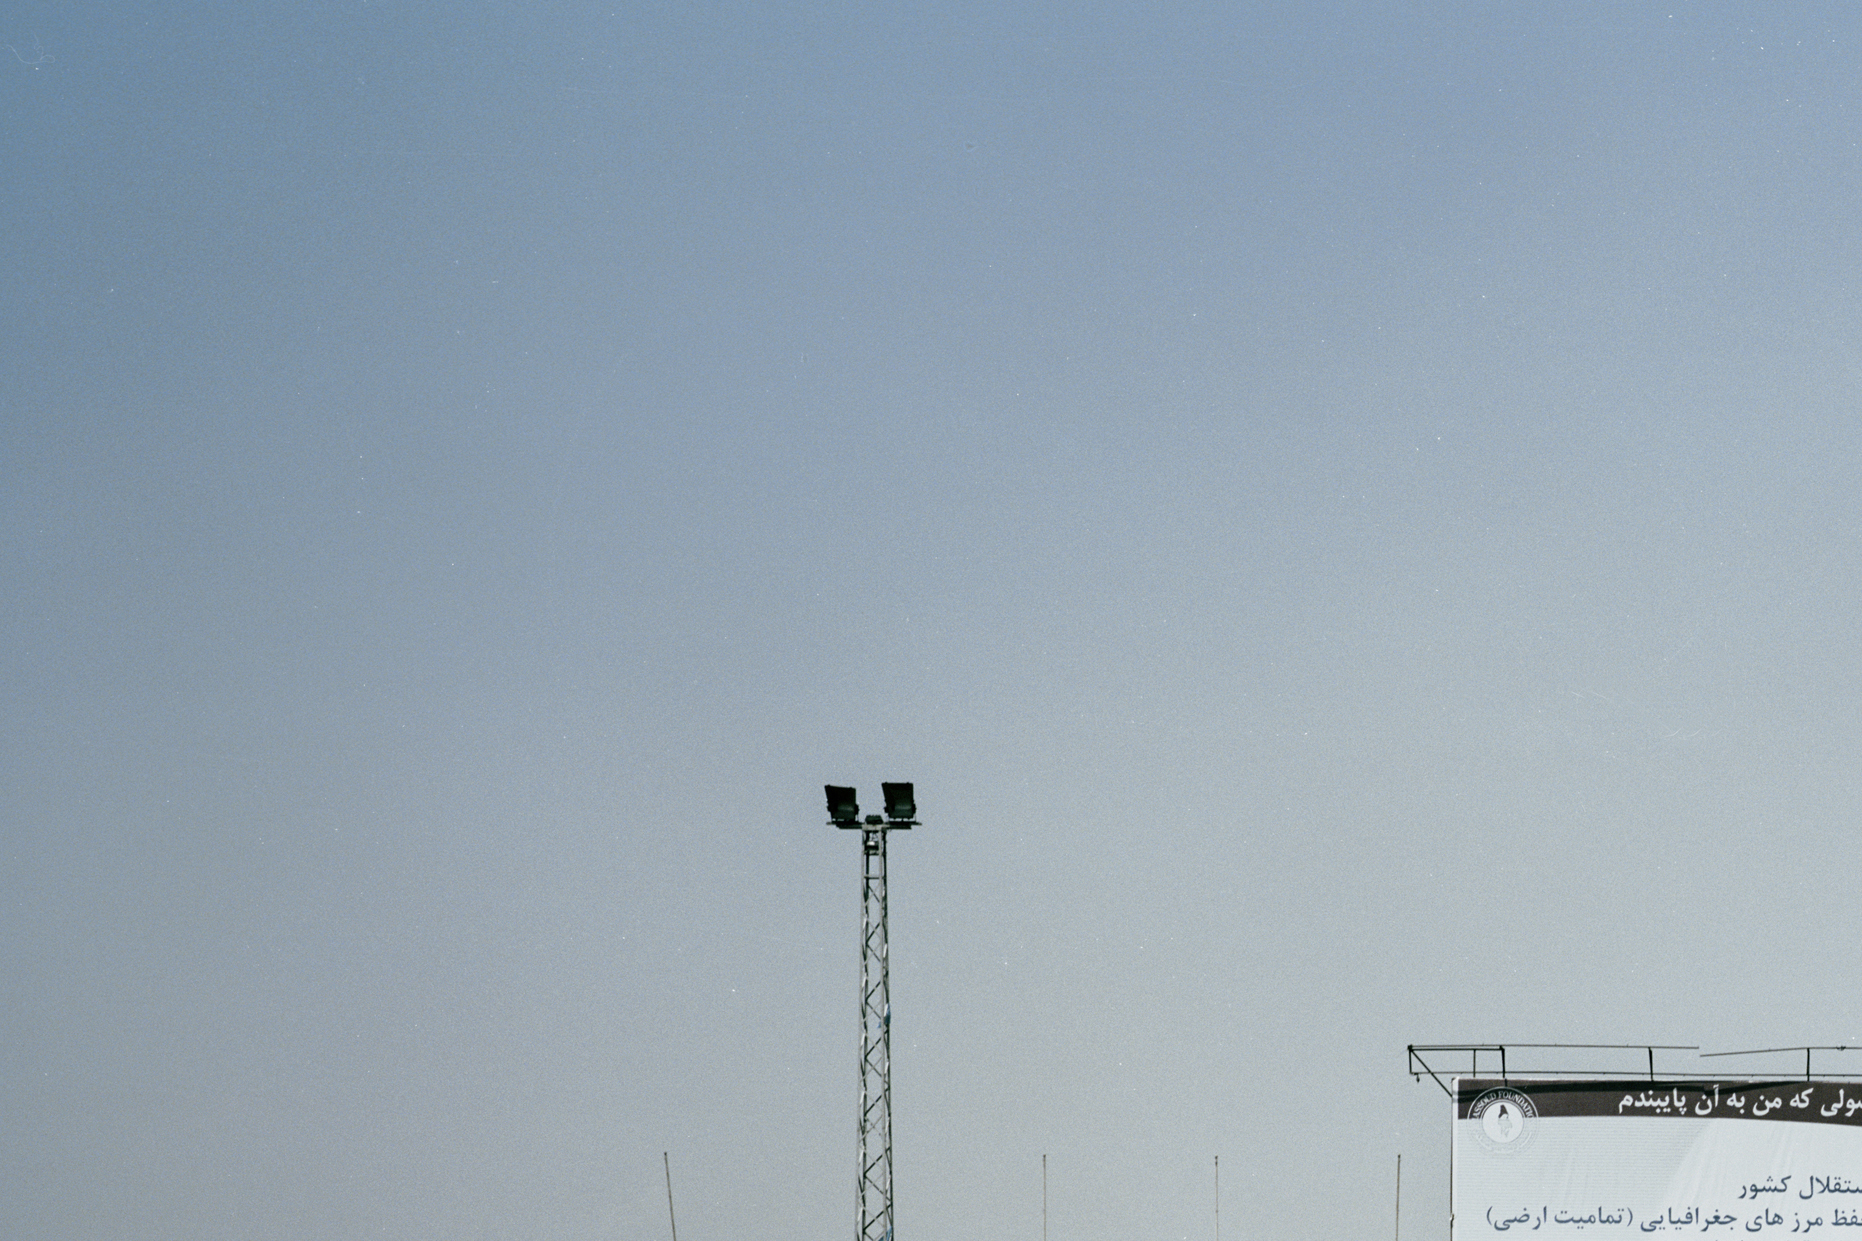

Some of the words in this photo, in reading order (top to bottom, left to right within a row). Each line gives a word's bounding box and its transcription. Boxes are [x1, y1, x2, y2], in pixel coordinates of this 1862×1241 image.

[1619, 1088, 1687, 1115] پایبندم
[1695, 1084, 1719, 1115] آن
[1727, 1093, 1745, 1114] به
[1753, 1095, 1782, 1116] من
[1790, 1088, 1813, 1108] که
[1738, 1175, 1792, 1200] کشور
[1640, 1206, 1738, 1233] جغرافیایی
[1745, 1207, 1784, 1233] های
[1791, 1212, 1823, 1234] مرز
